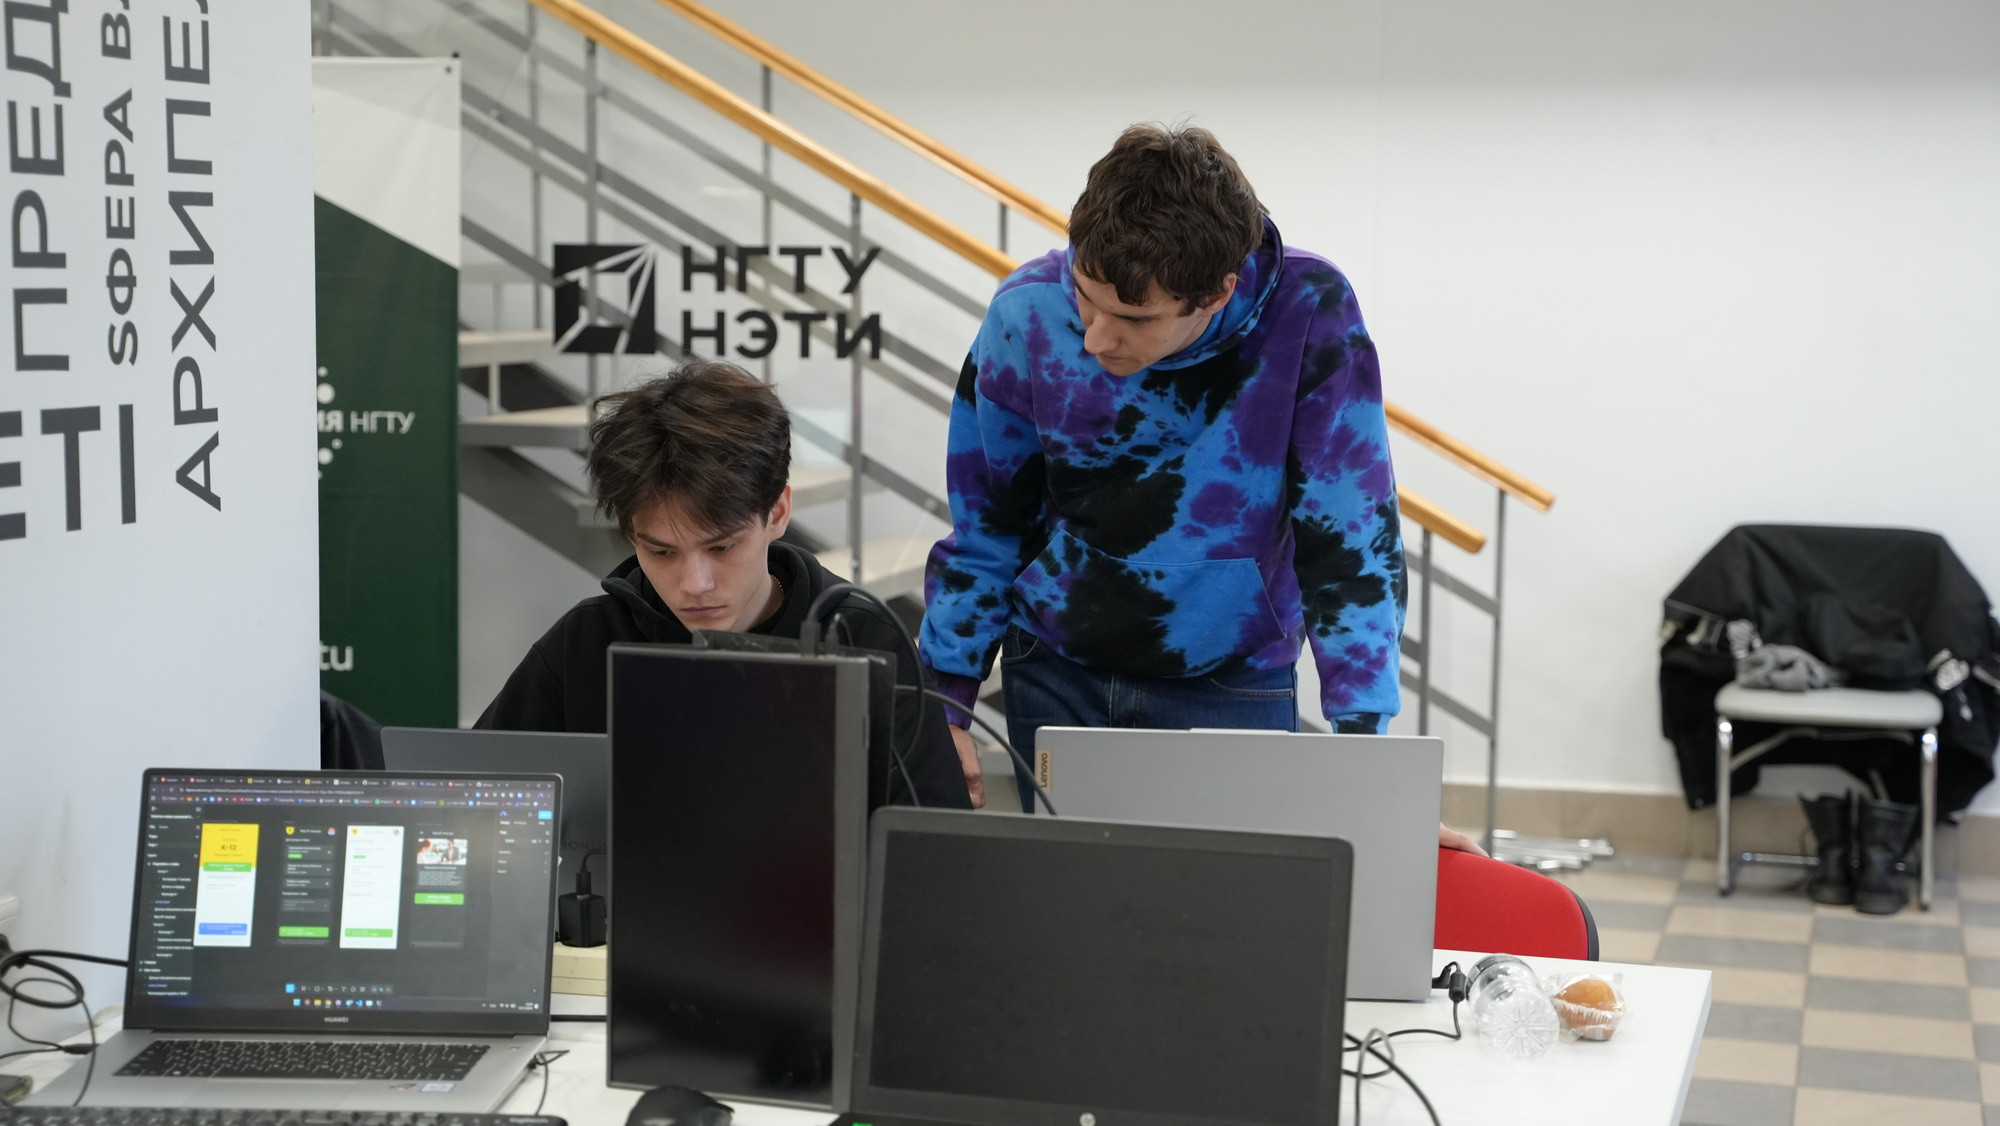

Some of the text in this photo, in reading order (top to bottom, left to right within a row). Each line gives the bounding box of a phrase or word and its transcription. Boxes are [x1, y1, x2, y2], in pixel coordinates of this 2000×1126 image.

[101, 0, 132, 60] В
[162, 0, 221, 512] АРХИПЕ
[681, 245, 882, 295] НГТУ
[681, 309, 881, 360] НЭТИ
[350, 410, 416, 434] НГТУ
